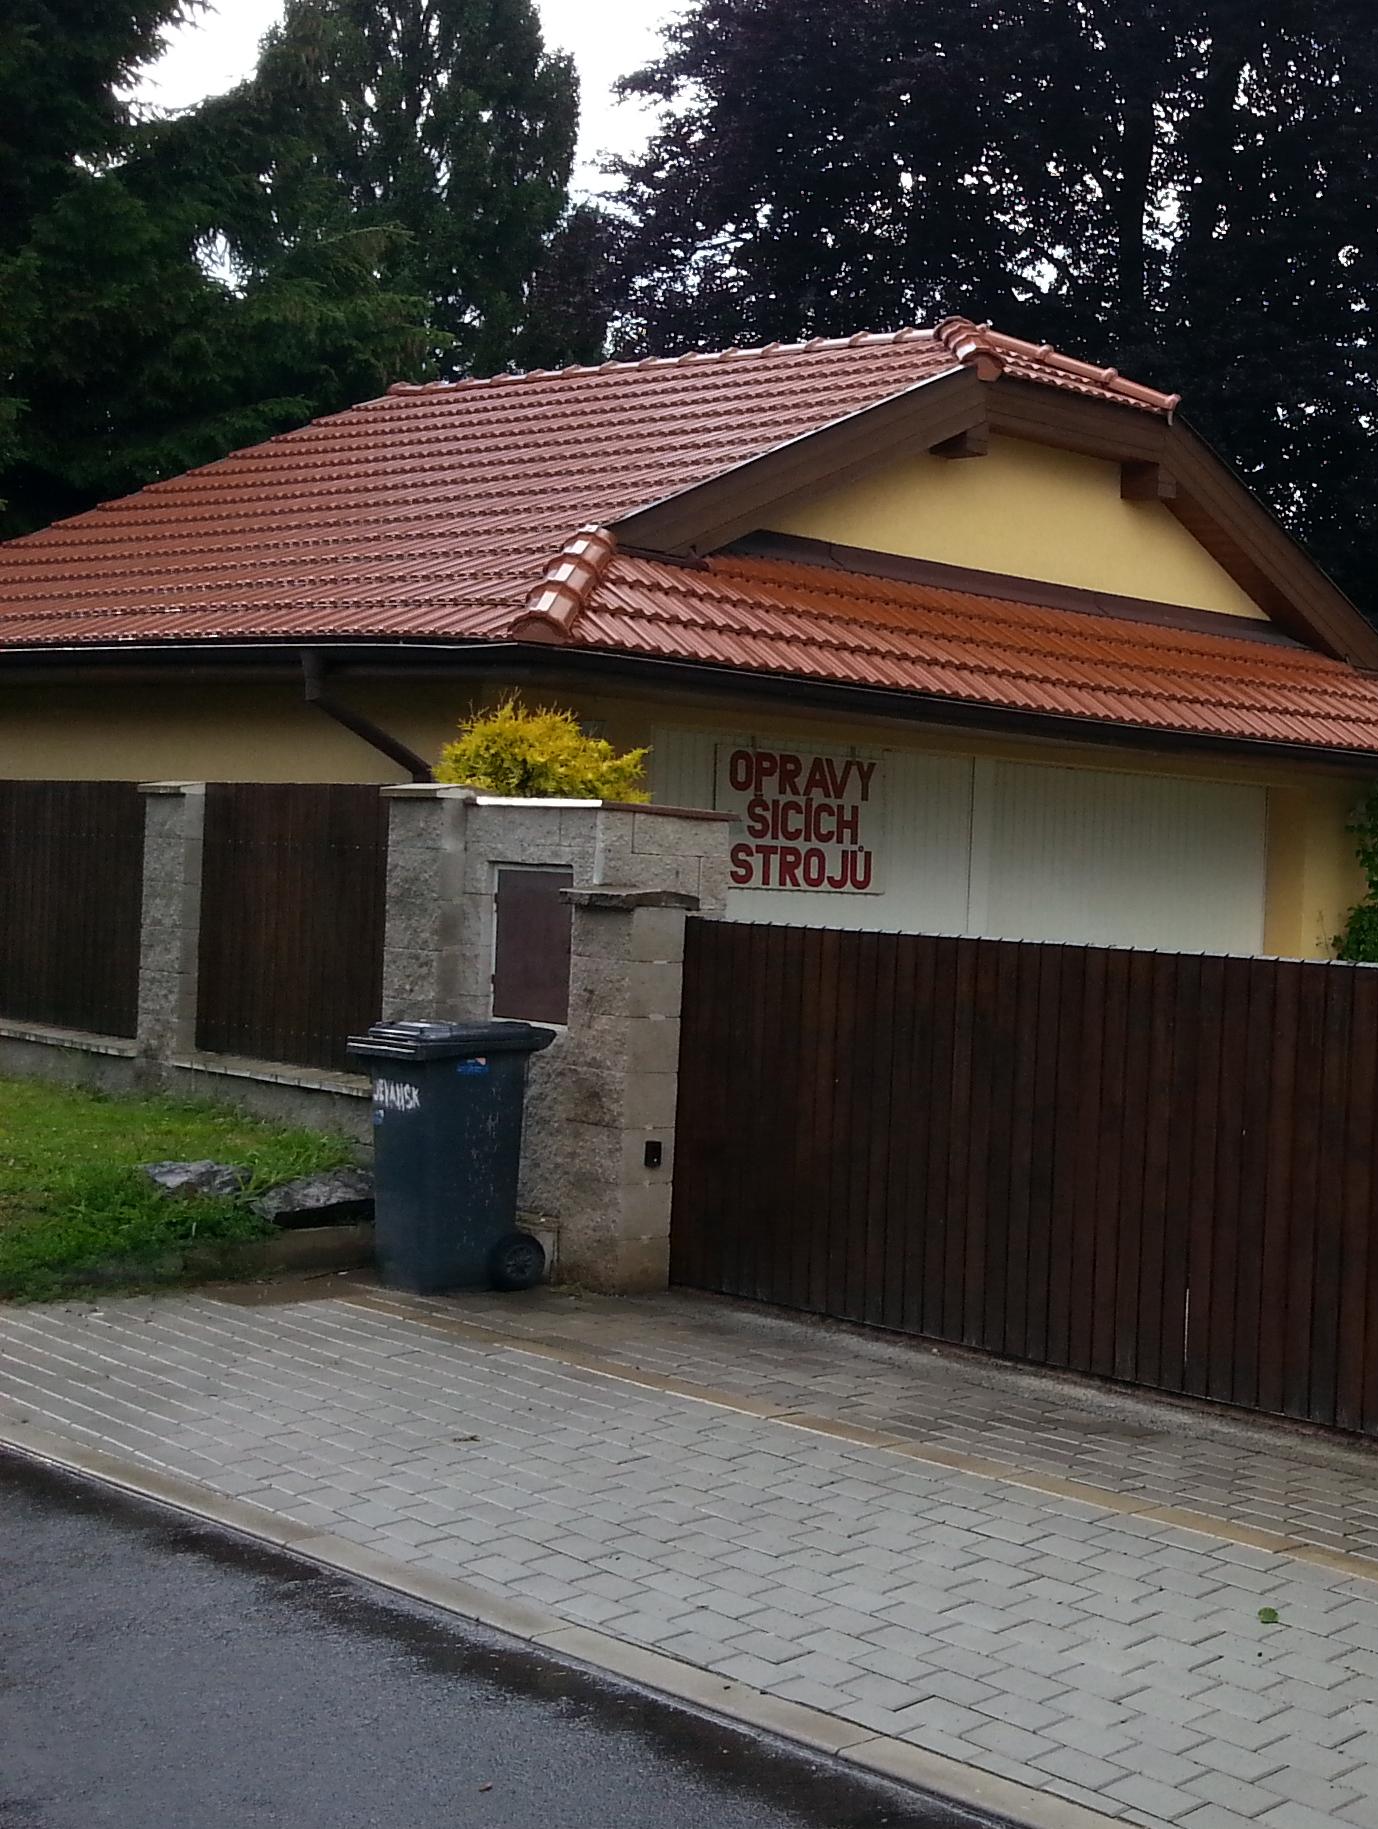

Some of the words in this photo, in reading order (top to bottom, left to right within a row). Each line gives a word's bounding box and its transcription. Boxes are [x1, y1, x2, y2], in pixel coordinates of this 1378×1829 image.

[729, 749, 877, 801] OPRAVY
[747, 791, 859, 845] ŠICÍCH
[730, 843, 872, 890] STROJŮ
